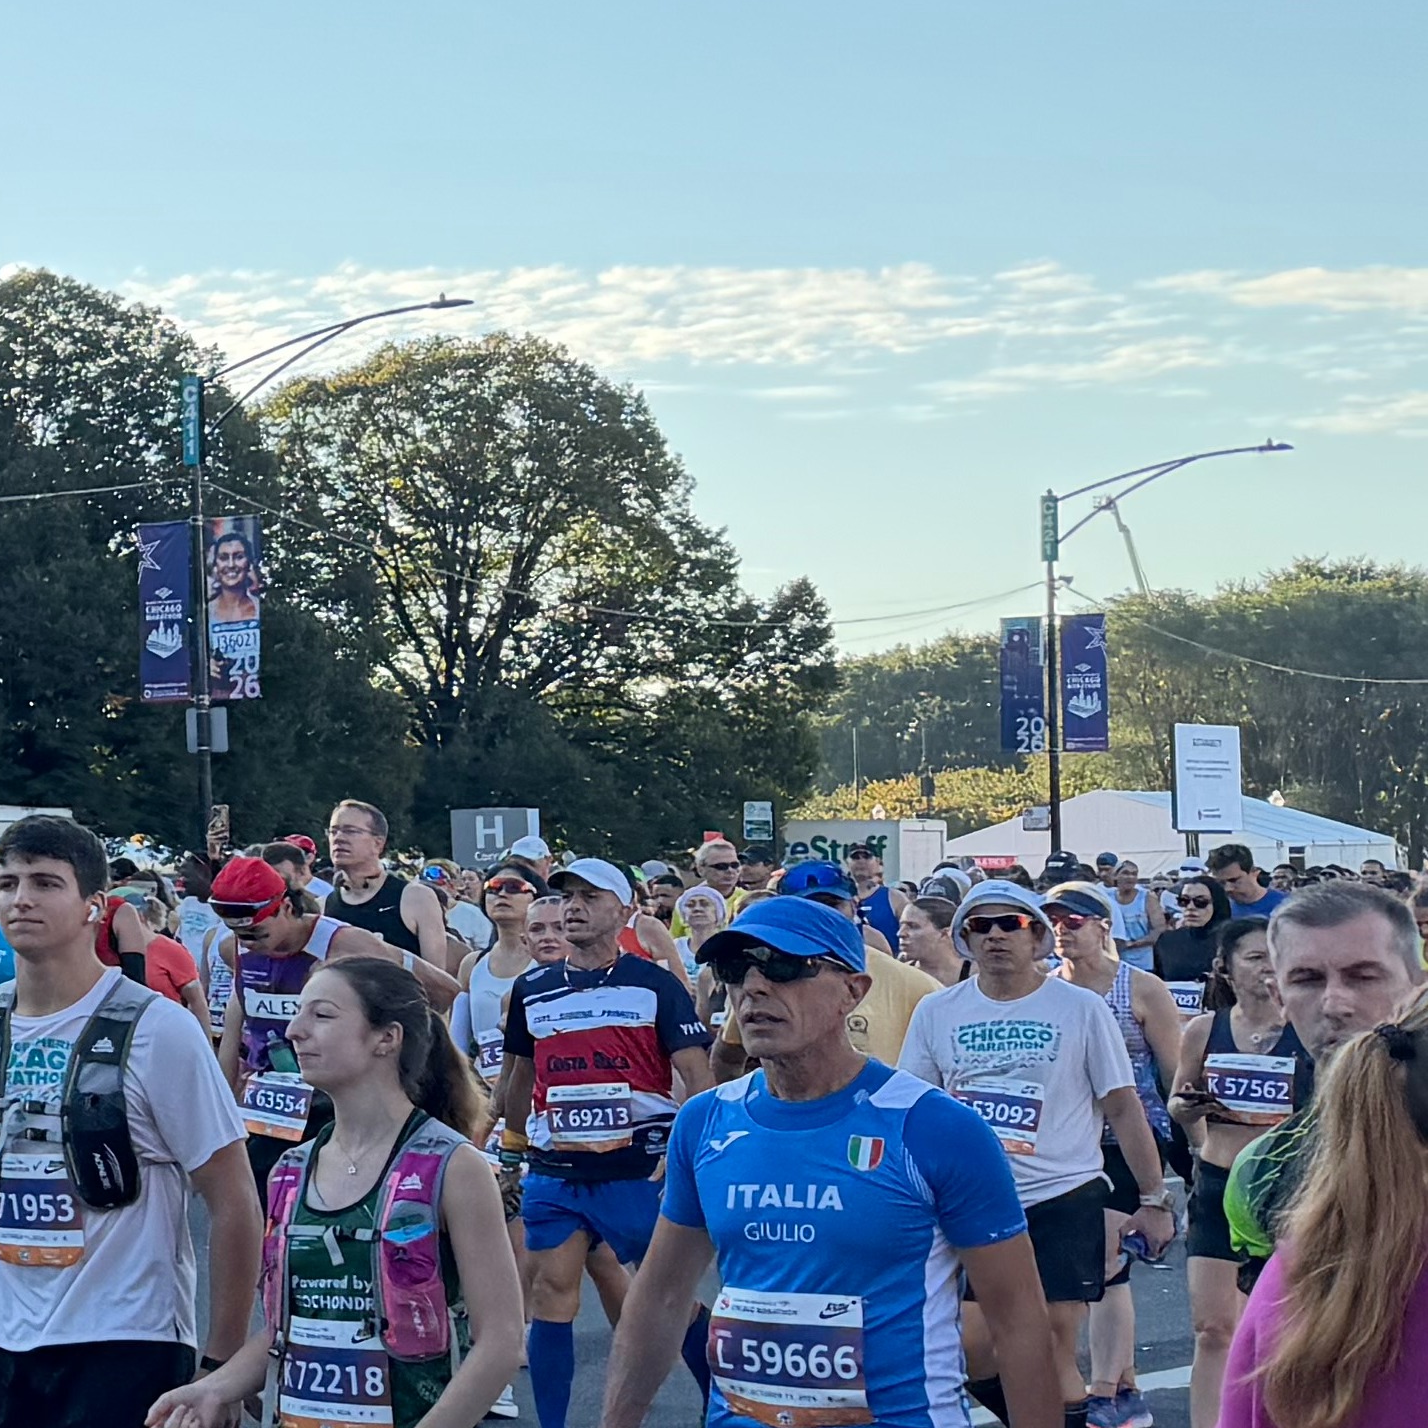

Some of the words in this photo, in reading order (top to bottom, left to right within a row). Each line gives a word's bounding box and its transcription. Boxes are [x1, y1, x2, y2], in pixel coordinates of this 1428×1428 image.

[183, 384, 197, 458] C411
[1043, 500, 1055, 557] C421
[229, 655, 260, 675] 20
[229, 674, 261, 700] 26
[1015, 716, 1045, 737] 20
[1016, 735, 1045, 754] 26
[475, 815, 504, 849] H
[957, 1027, 1053, 1045] CHICAGO
[965, 1041, 1045, 1052] MARATHON
[7, 1070, 65, 1085] ATHO
[1208, 1076, 1219, 1094] K
[1224, 1077, 1290, 1100] 57562
[244, 1088, 254, 1105] K
[255, 1089, 307, 1115] 63554
[551, 1110, 564, 1129] K
[569, 1107, 630, 1128] 69213
[726, 1184, 844, 1211] ITALIA
[744, 1221, 816, 1244] GIULIO
[291, 1274, 348, 1290] Powered
[353, 1274, 373, 1294] by
[716, 1337, 734, 1370] L
[742, 1338, 859, 1380] 59666
[295, 1360, 385, 1397] 72218
